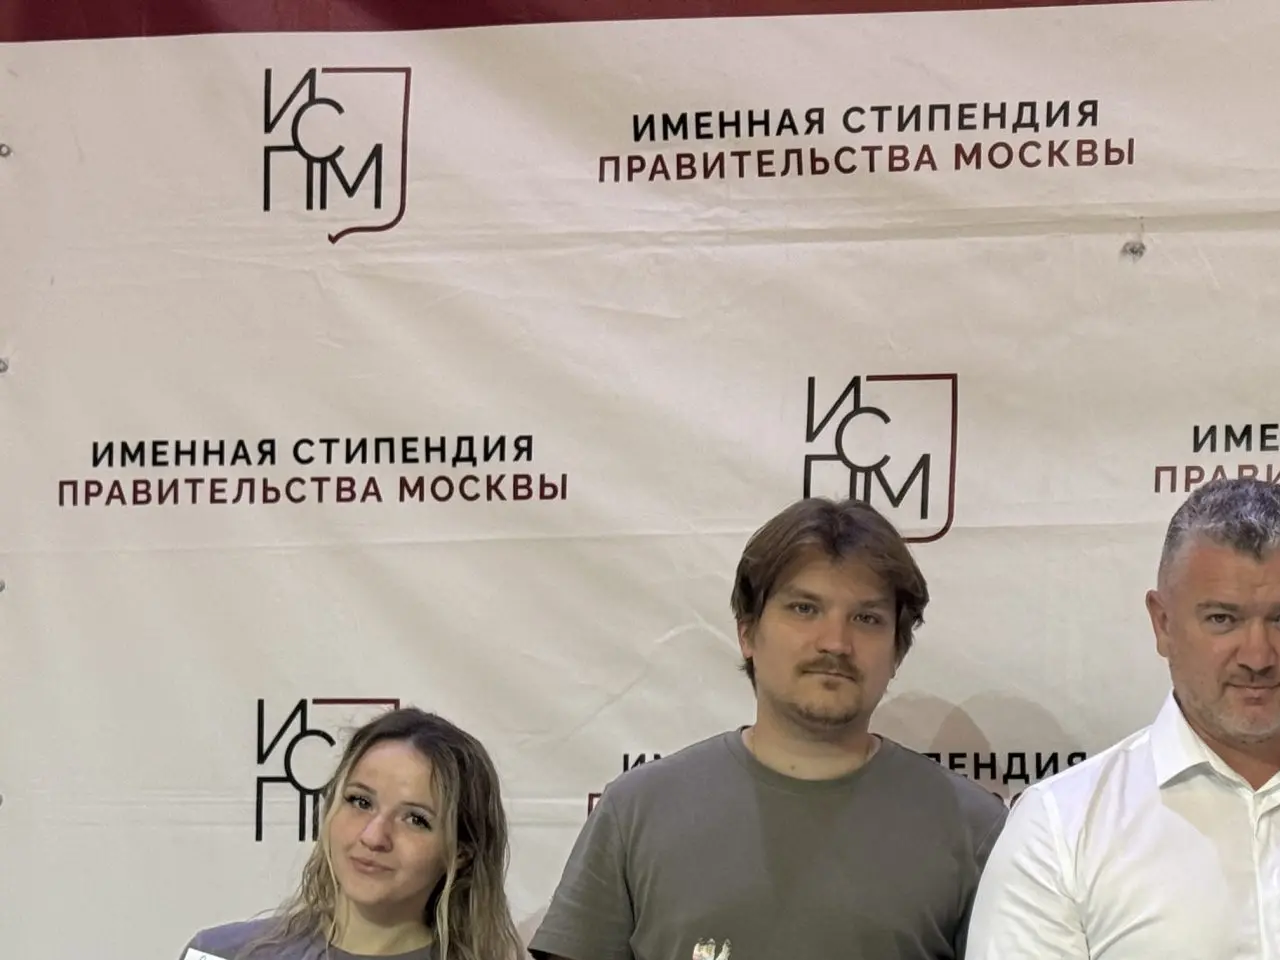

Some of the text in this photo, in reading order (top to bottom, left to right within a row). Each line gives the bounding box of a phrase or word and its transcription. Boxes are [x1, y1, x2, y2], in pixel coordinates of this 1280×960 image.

[633, 100, 1098, 142] ИМЕННАЯ СТИПЕНДИЯ
[599, 138, 1134, 183] ПРАВИТЕЛЬСТВА МОСКВЫ
[92, 435, 534, 468] ИМЕННАЯ СТИПЕНДИЯ
[59, 473, 568, 507] ПРАВИТЕЛЬСТВА МОСКВЫ
